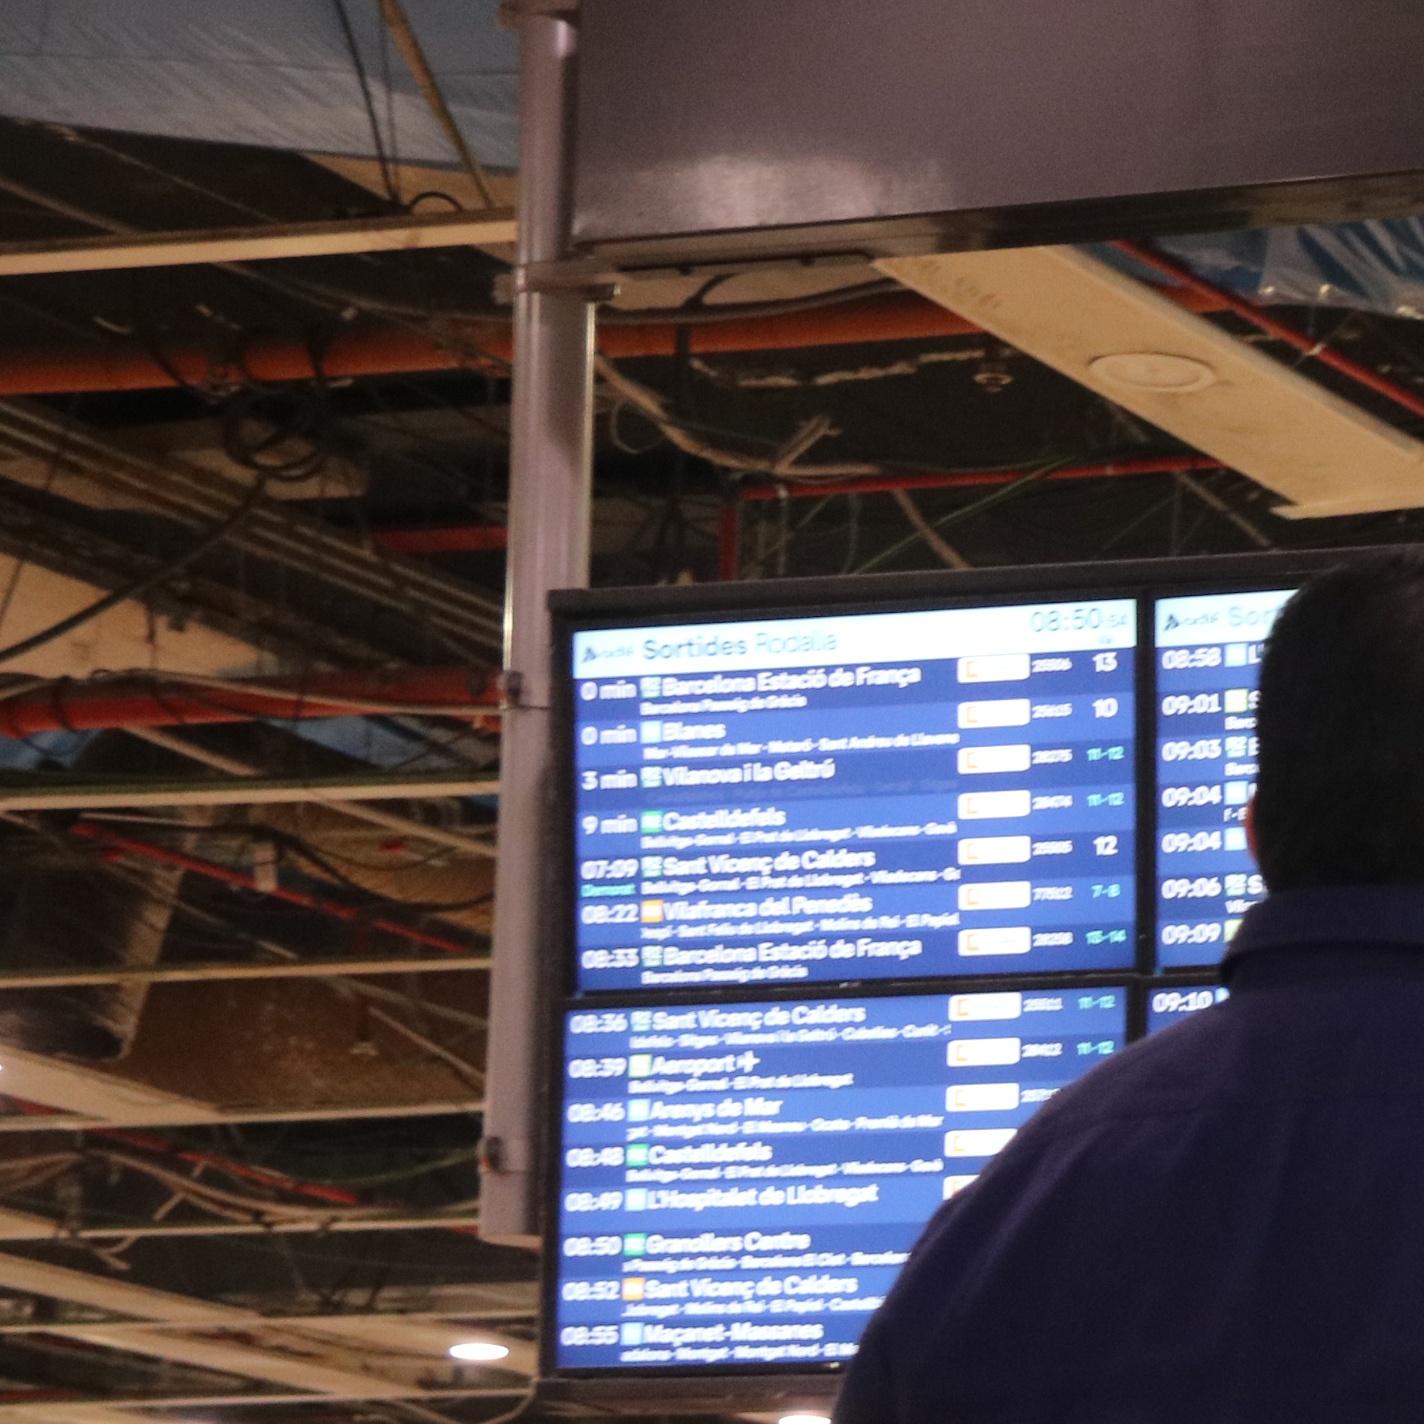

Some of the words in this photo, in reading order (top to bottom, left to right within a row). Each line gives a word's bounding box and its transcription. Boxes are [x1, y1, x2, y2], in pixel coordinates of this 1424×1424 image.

[643, 634, 747, 660] Sortides
[755, 630, 838, 654] Rodalia
[581, 682, 597, 700] 0
[600, 680, 636, 699] min
[661, 675, 755, 696] Barcelona
[757, 669, 827, 691] Estació
[827, 668, 855, 687] de
[856, 667, 921, 687] França
[1093, 652, 1117, 672] 13
[1162, 694, 1221, 715] 09:01
[581, 727, 597, 745] 0
[600, 725, 637, 743] min
[662, 722, 726, 741] Blanes
[1093, 698, 1118, 717] 10
[1162, 739, 1221, 761] 09:03
[582, 771, 598, 790] 3
[600, 770, 637, 788] min
[662, 767, 740, 785] Vilanova
[772, 759, 835, 780] Geltrú
[1162, 785, 1222, 807] 09:04
[583, 816, 598, 834] 9
[601, 815, 637, 833] min
[663, 807, 786, 830] Castelldefels
[1162, 831, 1221, 852] 09:04
[663, 857, 709, 876] Sant
[710, 854, 775, 875] Vicenç
[775, 851, 801, 870] de
[802, 849, 875, 869] Calders
[1093, 836, 1118, 855] 12
[1162, 877, 1221, 898] 09:06
[1162, 923, 1221, 944] 09:09
[652, 1055, 737, 1077] Aeroport
[650, 1101, 716, 1122] Arenys
[716, 1098, 744, 1117] de
[744, 1097, 783, 1115] Mar
[648, 1187, 753, 1211] L'Hospitalet
[754, 1186, 786, 1205] de
[786, 1184, 879, 1207] Llobregat
[647, 1233, 745, 1253] Granollers
[745, 1232, 810, 1251] Centre
